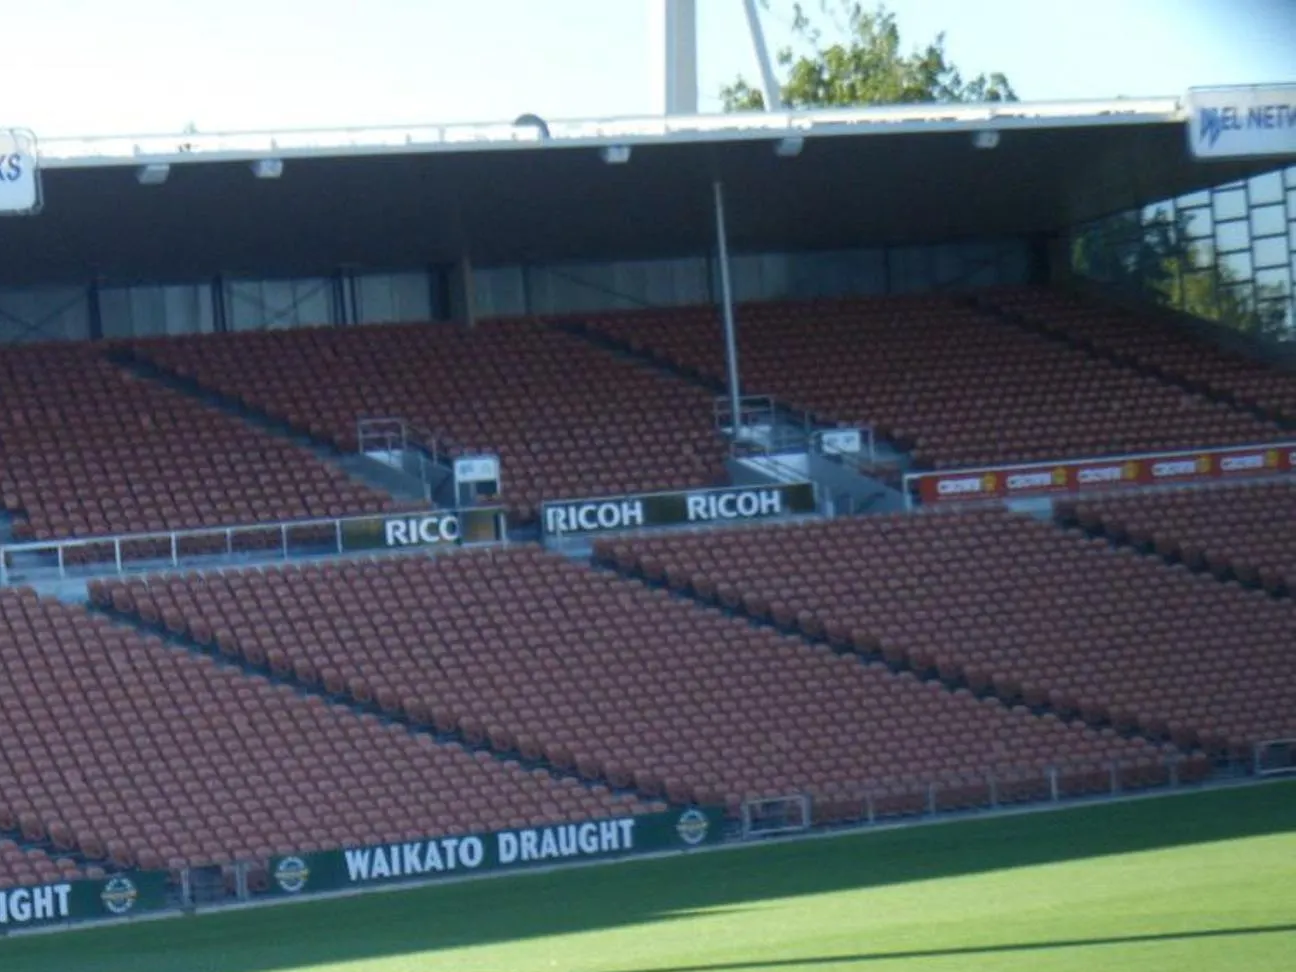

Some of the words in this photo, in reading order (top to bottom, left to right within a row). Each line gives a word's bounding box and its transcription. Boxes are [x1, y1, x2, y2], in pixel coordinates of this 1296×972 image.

[546, 501, 644, 533] RICOH
[686, 490, 782, 522] RICOH
[345, 836, 484, 882] WAIKATO
[498, 819, 635, 864] DRAUGHT
